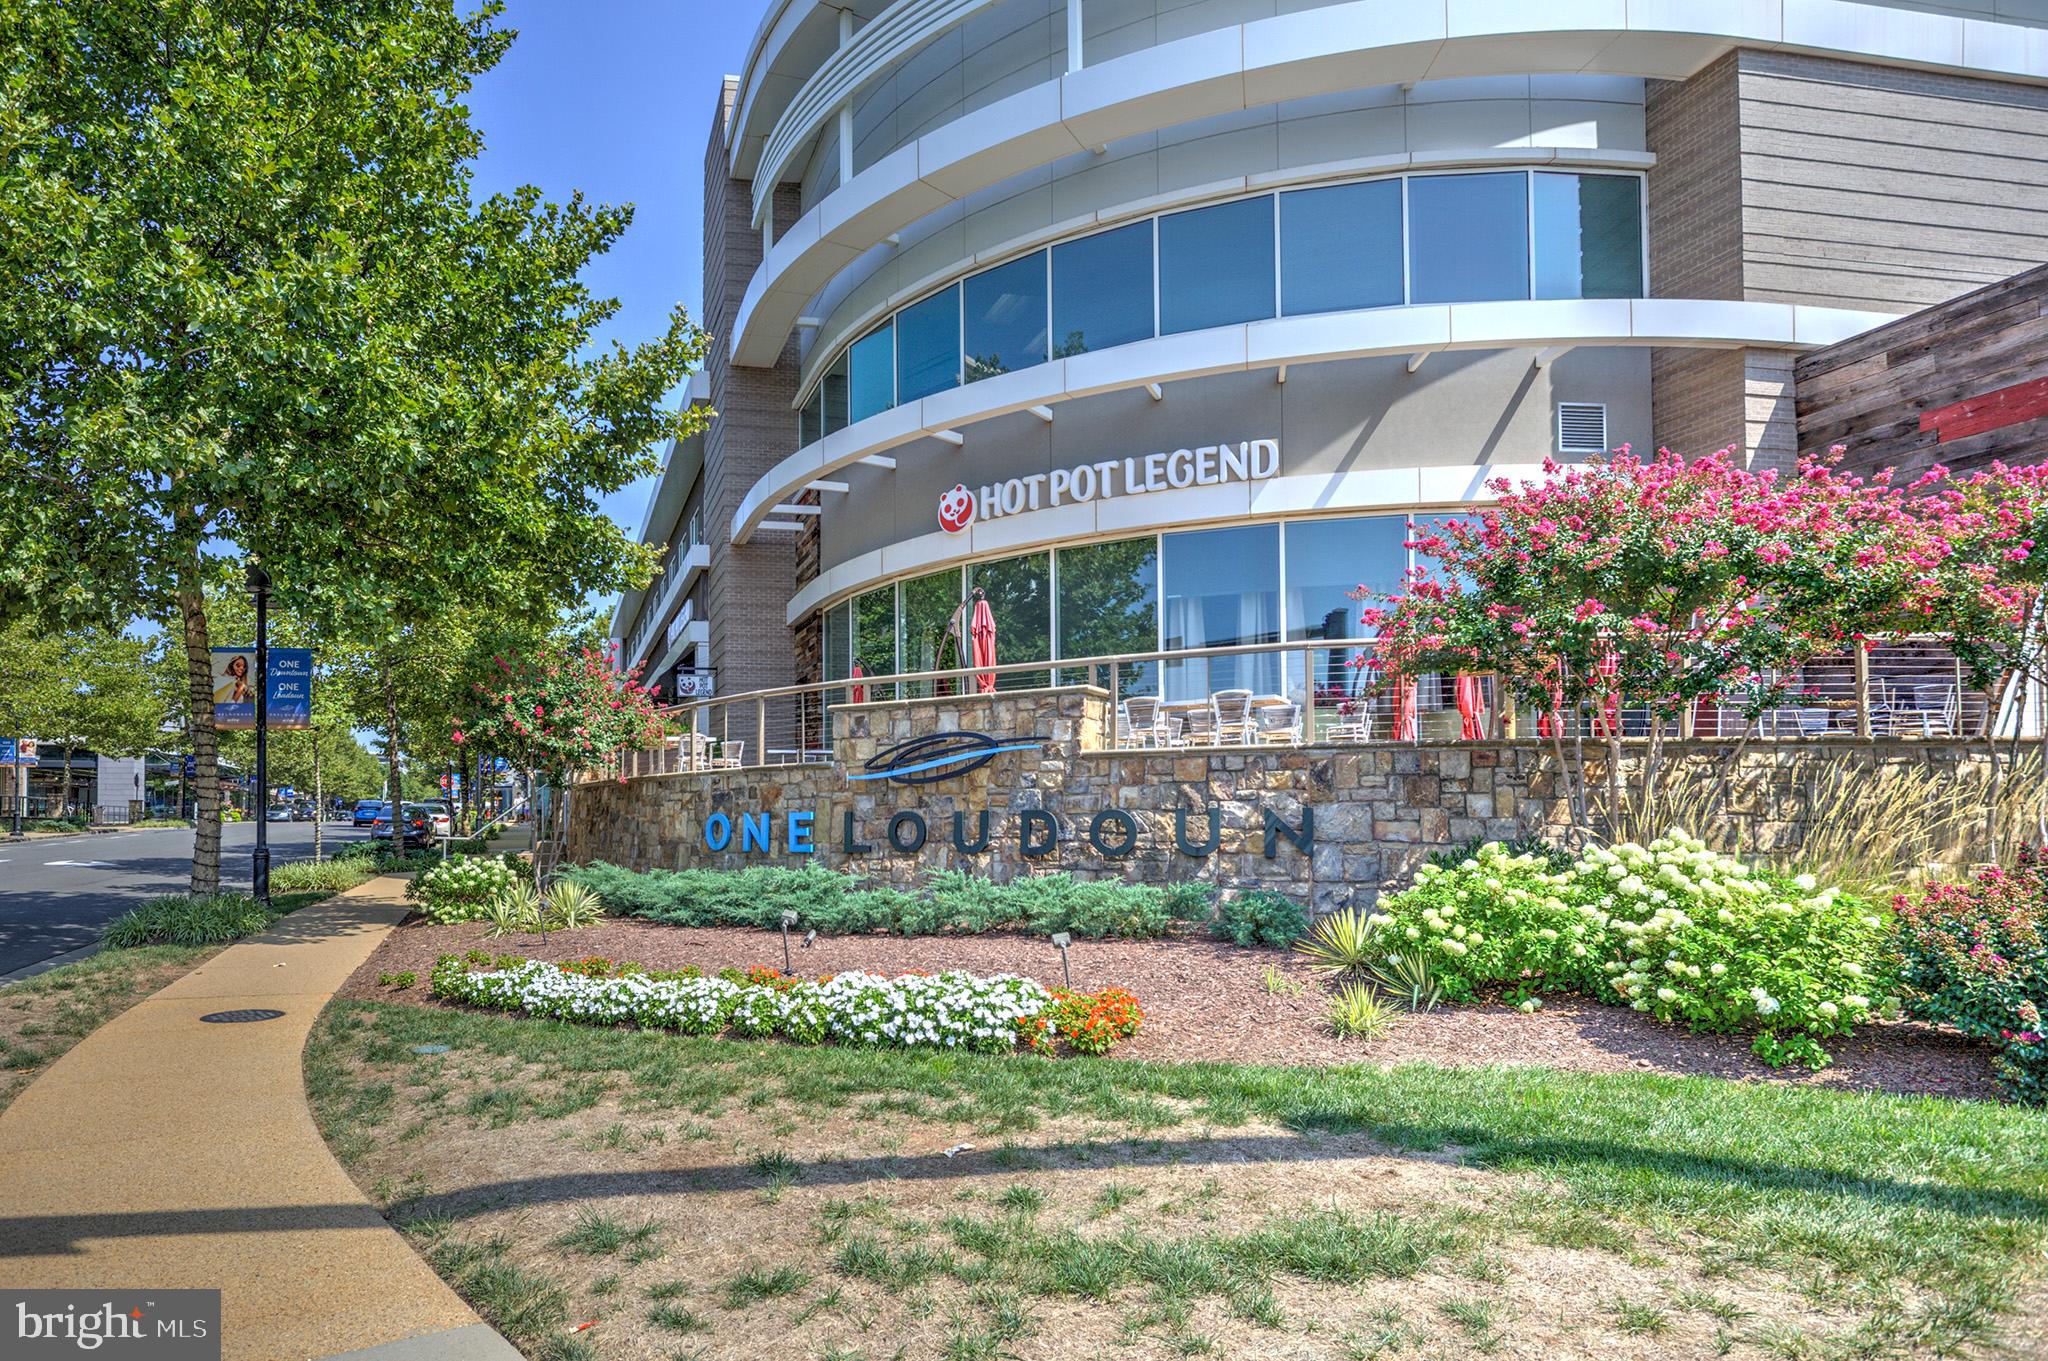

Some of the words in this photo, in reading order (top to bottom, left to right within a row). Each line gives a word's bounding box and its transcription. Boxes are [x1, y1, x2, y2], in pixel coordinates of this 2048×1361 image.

[981, 474, 1045, 520] HOT
[1050, 460, 1119, 507] POT
[1125, 439, 1280, 495] LEGEND
[279, 660, 300, 668] ONE
[278, 682, 299, 690] ONE
[705, 812, 815, 853] ONE
[844, 807, 1314, 858] LOUDOUN
